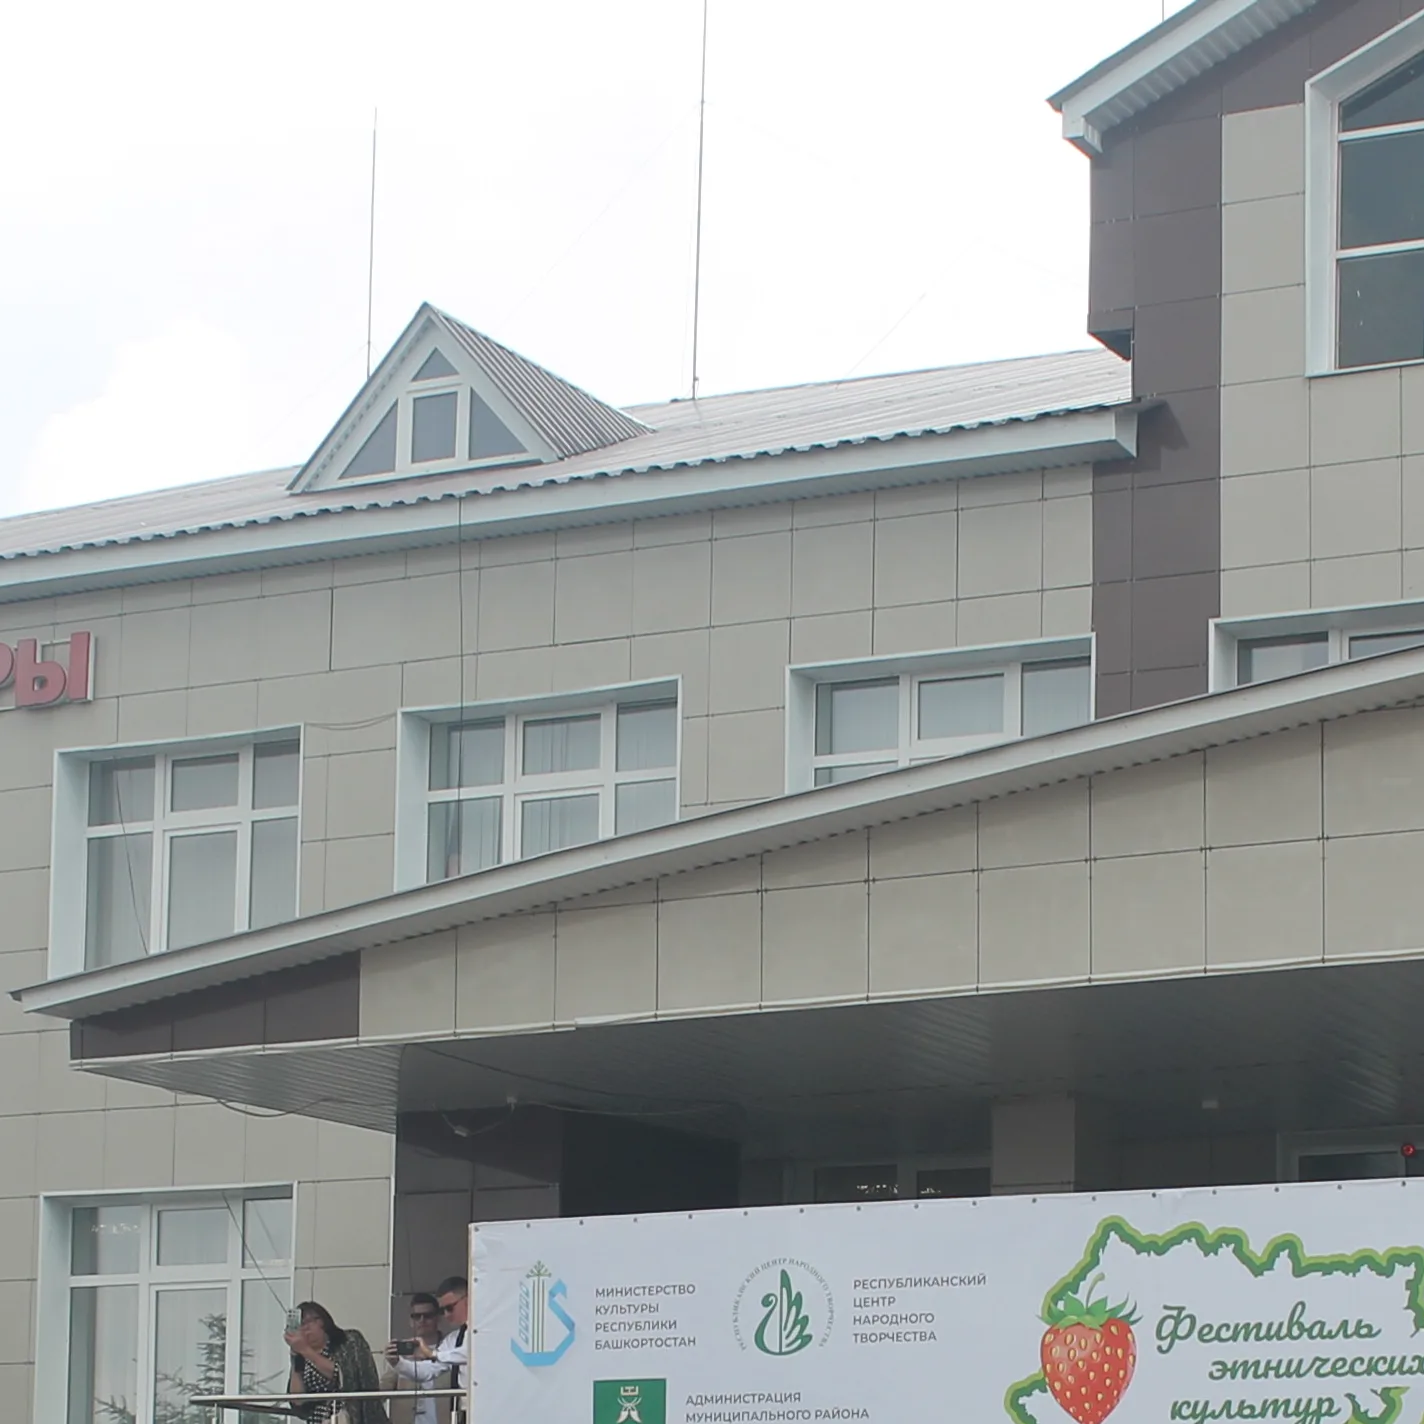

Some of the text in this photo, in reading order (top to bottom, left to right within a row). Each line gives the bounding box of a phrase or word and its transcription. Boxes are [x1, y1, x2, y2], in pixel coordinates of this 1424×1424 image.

[853, 1273, 986, 1290] РЕСПУБЛИКАНСКИЙ
[595, 1283, 696, 1298] МИНИСТЕРСТВО
[595, 1303, 659, 1316] КУЛЬТУРЫ
[853, 1296, 896, 1309] ЦЕНТР
[595, 1319, 677, 1333] РЕСПУБЛИКИ
[853, 1312, 935, 1326] НАРОДНОГО
[1155, 1300, 1382, 1354] Фестиваль
[594, 1336, 697, 1350] БАШКОРТОСТАН
[852, 1330, 937, 1344] ТВОРЧЕСТВА
[685, 1392, 801, 1407] АДМИНИСТРАЦИЯ
[685, 1407, 870, 1424] МУНИЦИПАЛЬНОГО РАЙОНА
